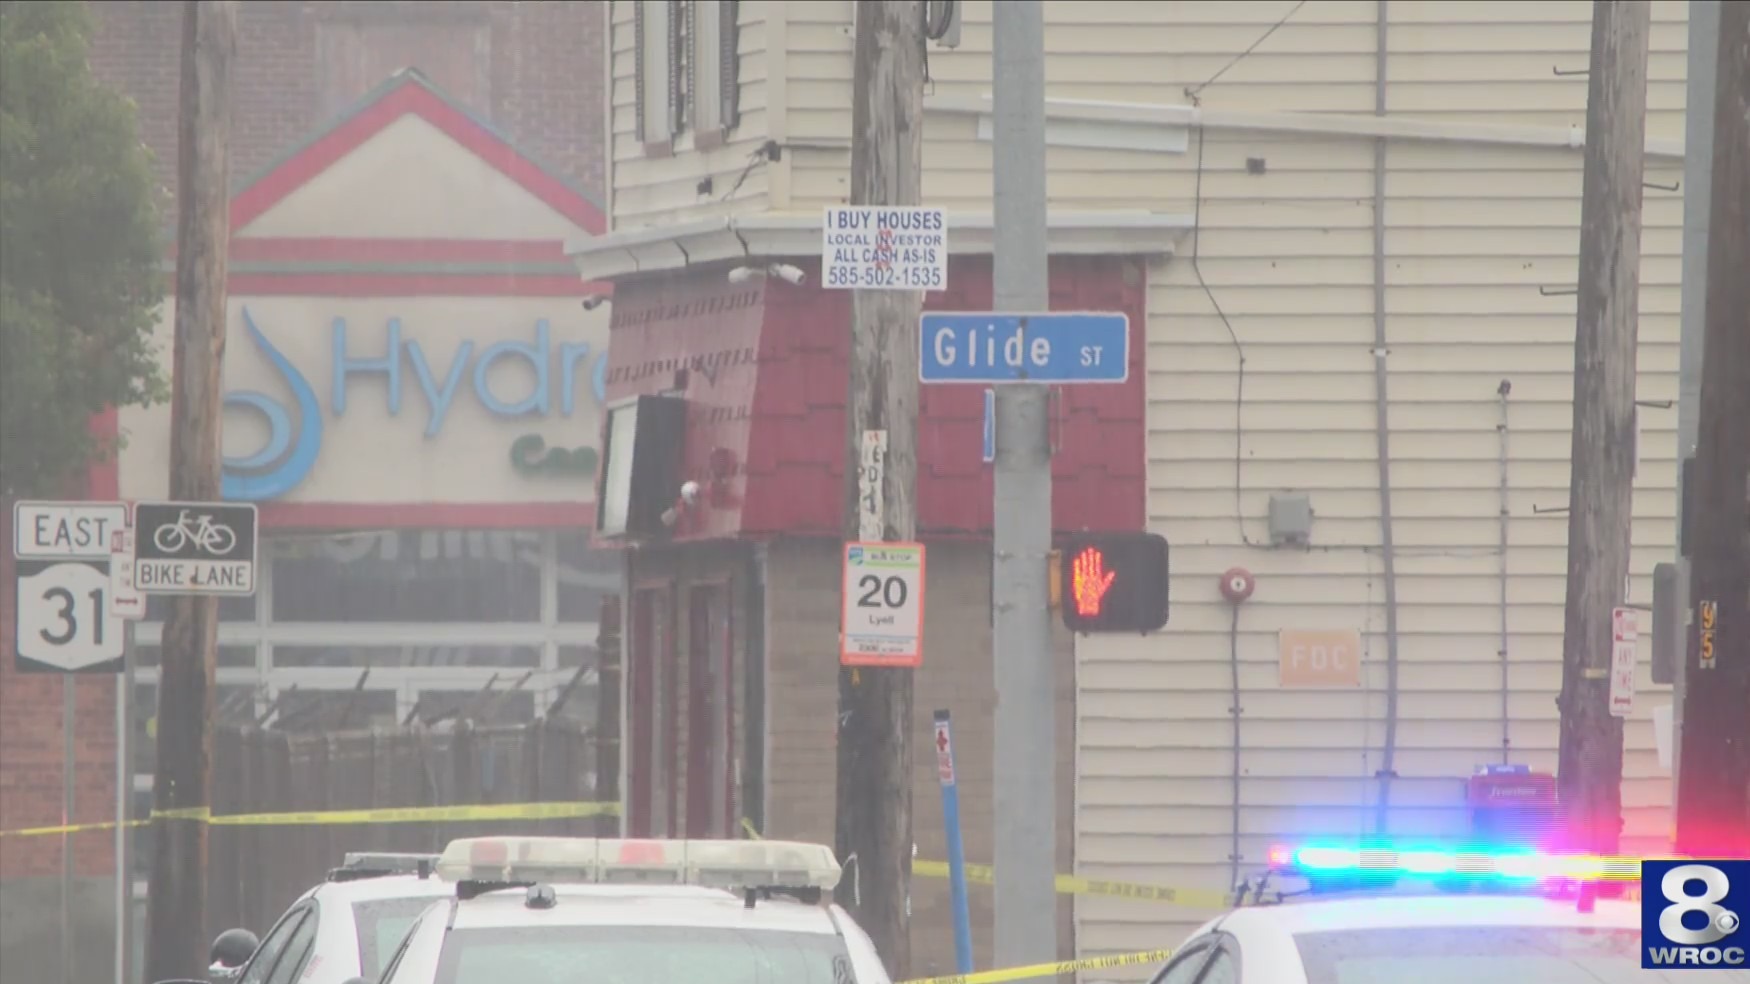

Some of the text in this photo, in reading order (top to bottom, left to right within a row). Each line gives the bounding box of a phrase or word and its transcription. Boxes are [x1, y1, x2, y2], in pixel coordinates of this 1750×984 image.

[827, 211, 942, 230] I BUY HOUSES
[828, 234, 941, 246] LOCAL INVESTOR
[834, 248, 936, 263] ALL CASH AS-IS
[828, 266, 941, 286] 585-502-1535
[934, 323, 1103, 367] Glide ST
[332, 316, 609, 440] Hydr
[35, 514, 109, 547] EAST
[140, 563, 184, 585] BIKE
[194, 565, 246, 586] LANE
[857, 574, 908, 609] 20
[39, 586, 104, 646] 31
[1291, 645, 1348, 671] FDC
